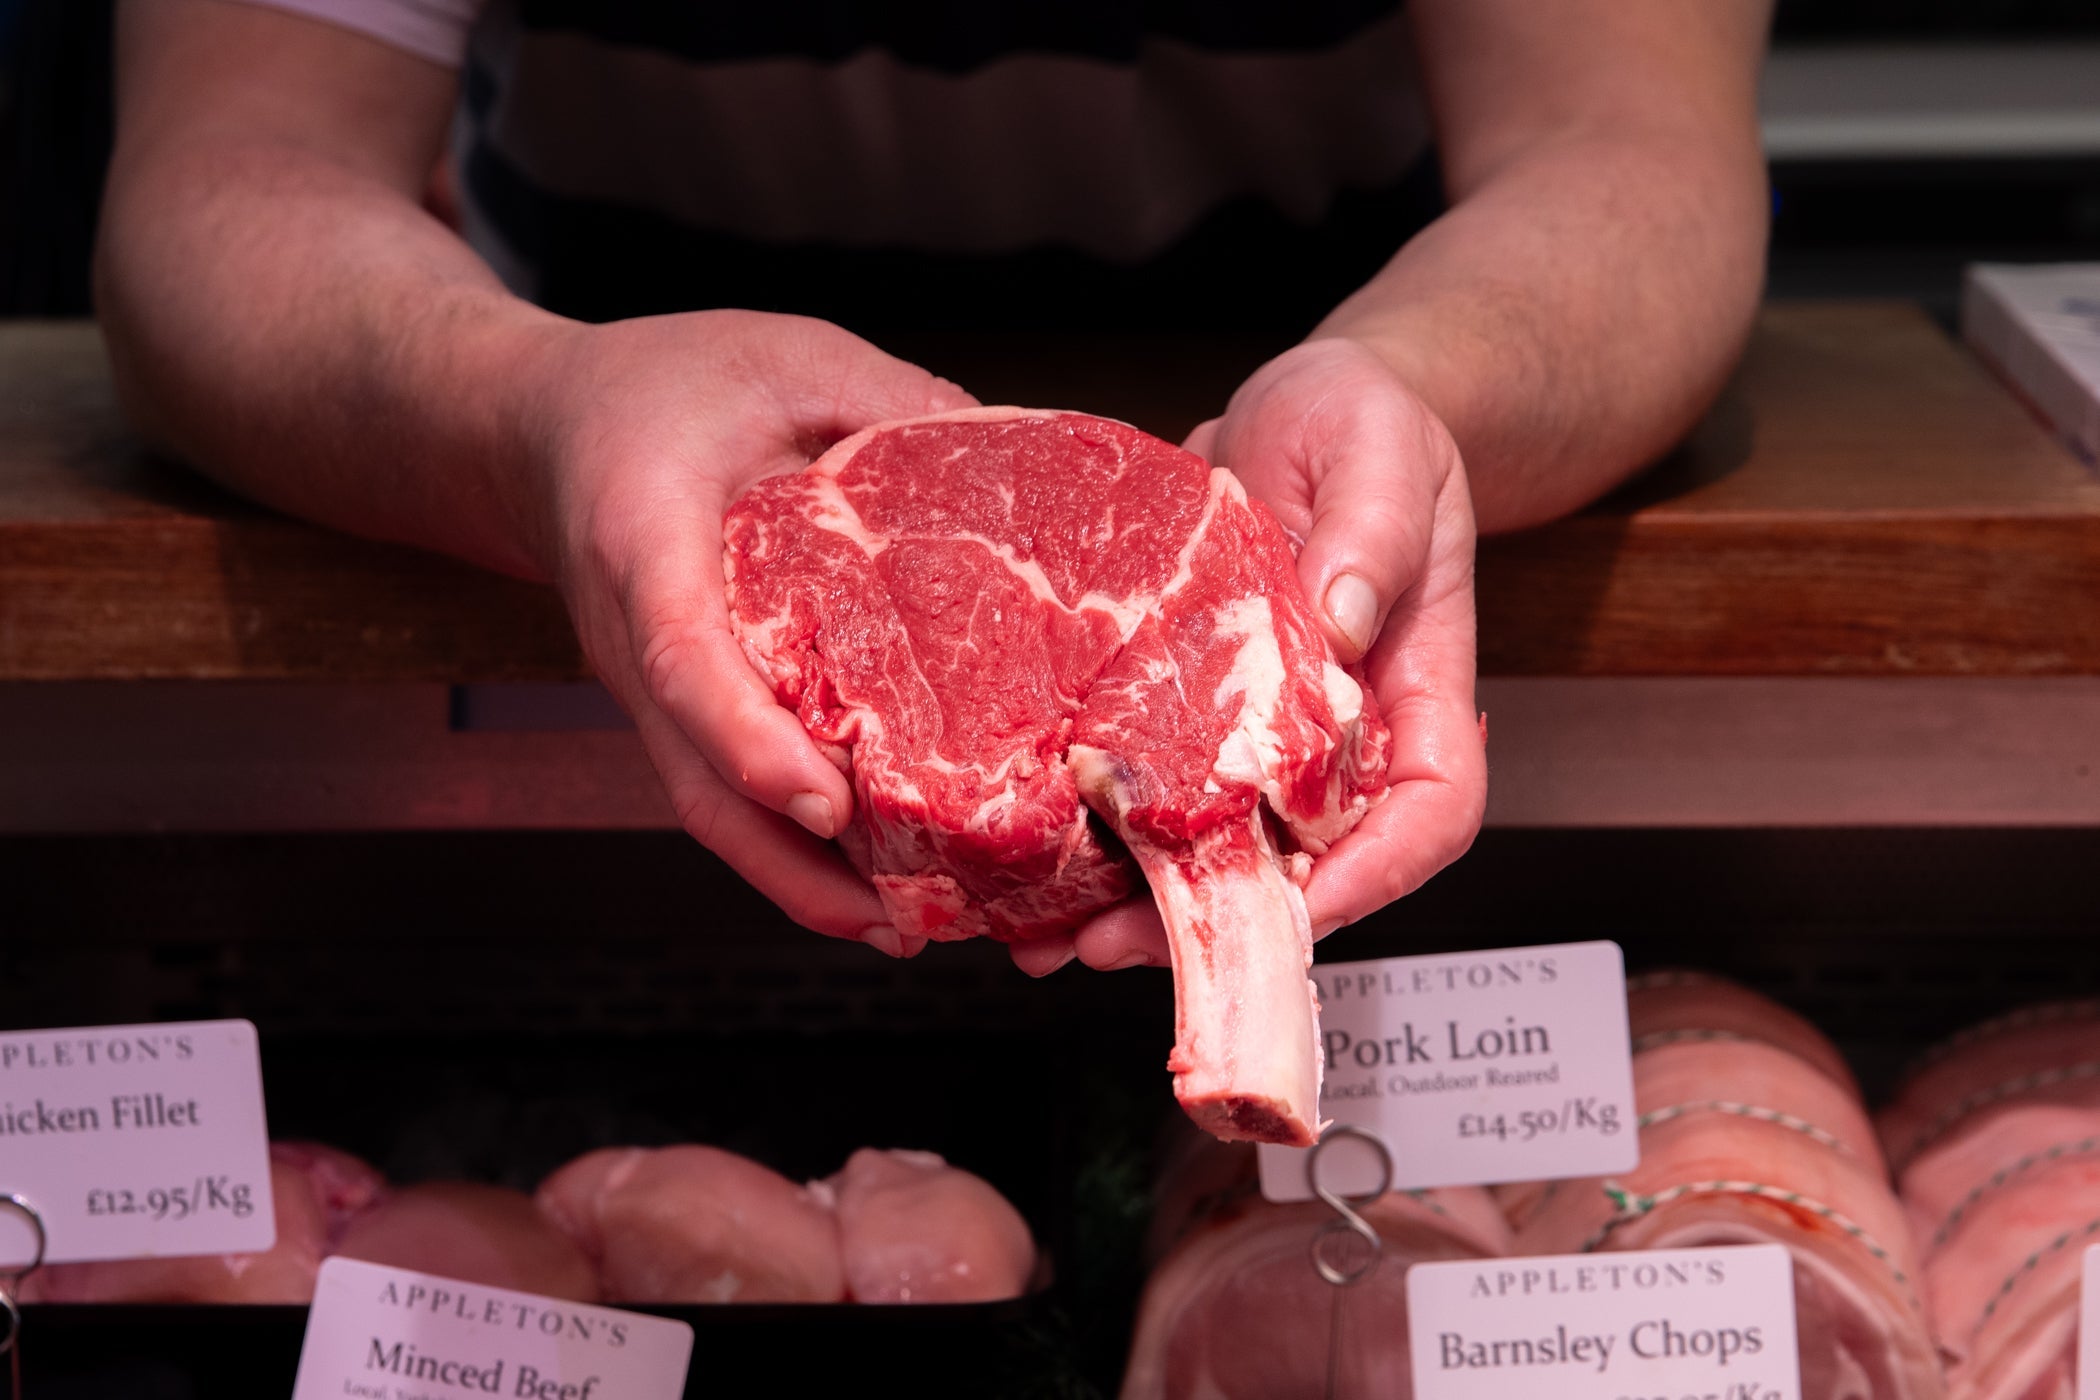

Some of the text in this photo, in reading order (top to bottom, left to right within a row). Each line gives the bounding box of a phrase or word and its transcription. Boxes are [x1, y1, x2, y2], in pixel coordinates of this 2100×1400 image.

[1324, 1015, 1551, 1071] Pork Loin
[1387, 1069, 1480, 1097] Outdoor
[1485, 1062, 1561, 1089] Reared
[110, 1093, 200, 1130] Fillet
[1457, 1097, 1623, 1141] £14.50/Kg
[86, 1175, 254, 1221] £12.95/Kg
[1470, 1259, 1727, 1298] APPLETON'S
[378, 1280, 631, 1348] APPLETON'S
[365, 1337, 601, 1400] Minced Beef
[1438, 1318, 1764, 1373] Barnsley Chops
